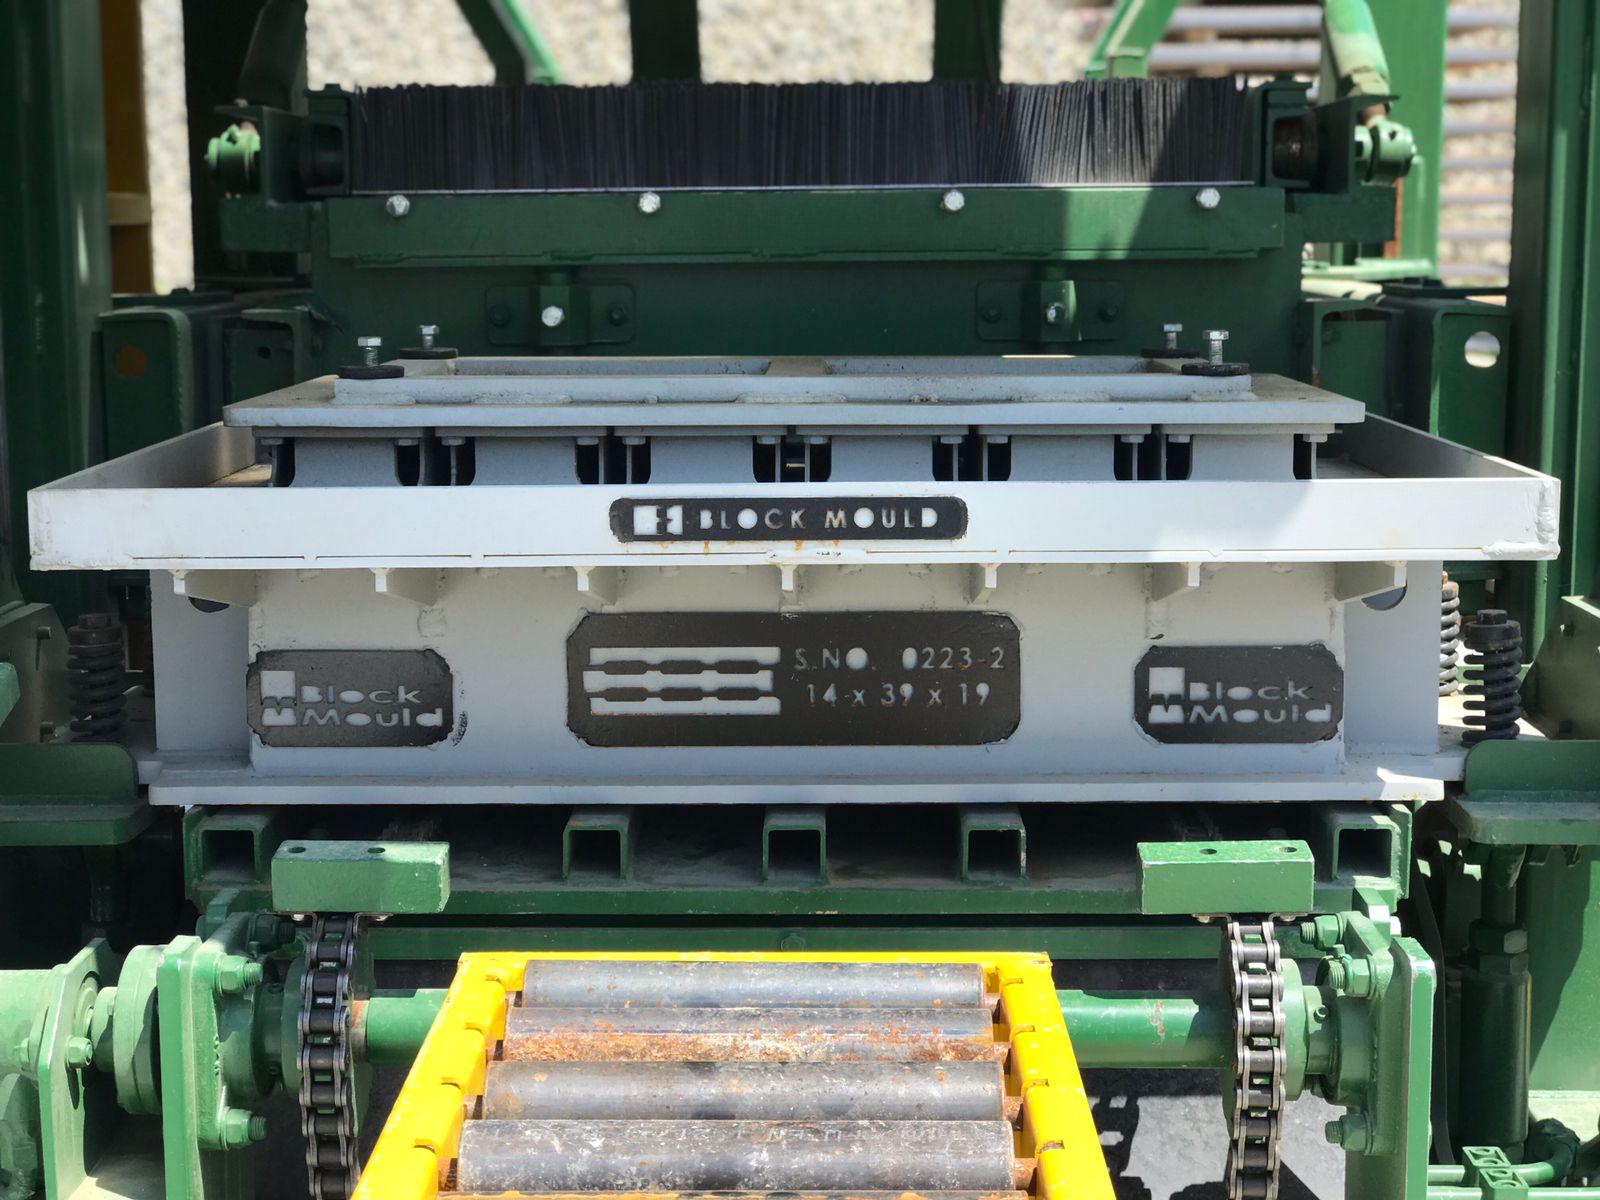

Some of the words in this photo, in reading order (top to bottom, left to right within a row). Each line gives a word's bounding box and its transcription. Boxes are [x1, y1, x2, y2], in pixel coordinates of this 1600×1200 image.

[699, 507, 806, 530] BLOCK
[824, 507, 939, 530] MOULD
[901, 647, 1005, 670] 0223-2
[301, 685, 422, 704] Block
[807, 683, 838, 707] 14
[880, 683, 914, 708] 39
[928, 688, 943, 707] x
[959, 682, 990, 705] 19
[1189, 681, 1314, 701] Block
[301, 707, 444, 727] Mould
[1188, 703, 1333, 724] Mould
